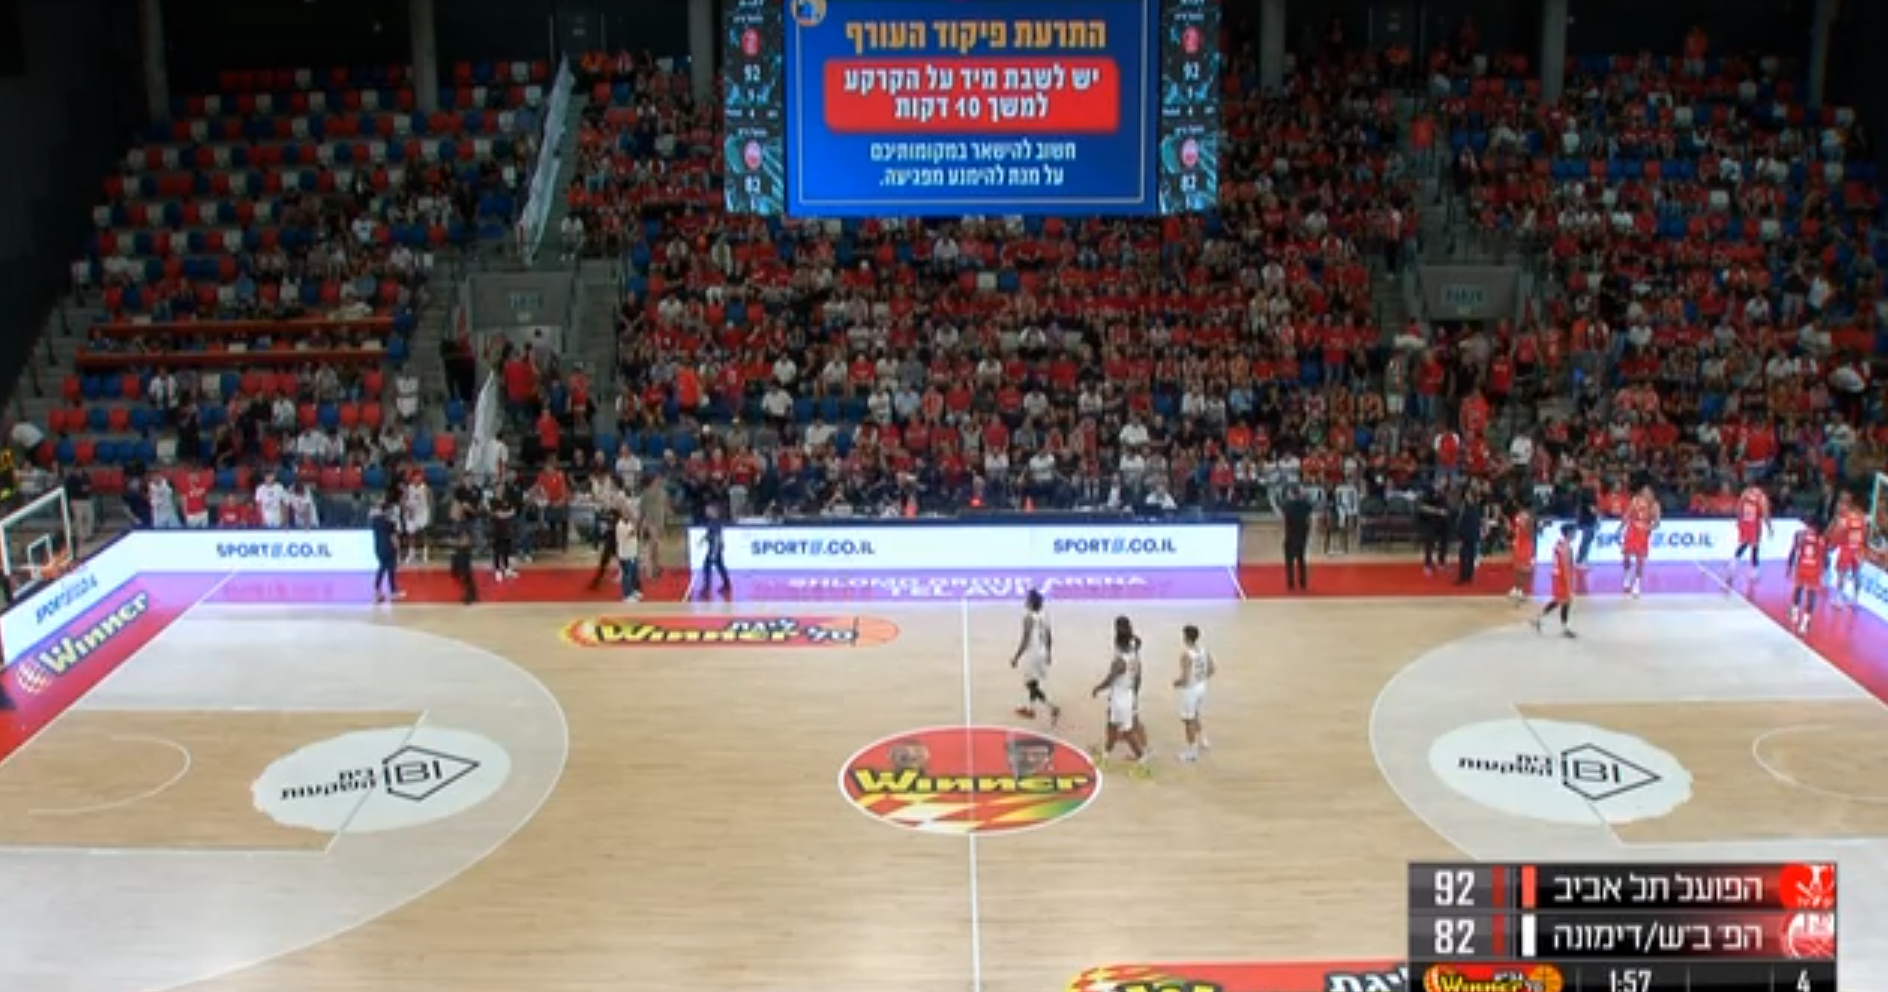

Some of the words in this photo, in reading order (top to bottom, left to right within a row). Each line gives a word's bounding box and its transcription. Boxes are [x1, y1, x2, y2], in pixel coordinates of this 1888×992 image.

[845, 20, 926, 55] העורף
[933, 20, 1007, 55] פיקוד
[1013, 20, 1107, 49] התרעת
[844, 66, 921, 96] הקרקע
[925, 64, 953, 91] על
[960, 66, 997, 91] מיד
[1003, 63, 1066, 91] לשבת
[1070, 66, 1100, 91] יש
[894, 96, 950, 123] דקות
[954, 96, 980, 119] 10
[986, 92, 1049, 123] למשך
[869, 141, 968, 165] במקומותיכם
[970, 137, 1031, 161] להישאר
[1034, 141, 1077, 161] חשוב
[947, 164, 1004, 186] להימנע
[1007, 166, 1041, 186] מנת
[1042, 164, 1065, 186] על
[37, 590, 149, 675] Winner
[853, 767, 1090, 794] Winner
